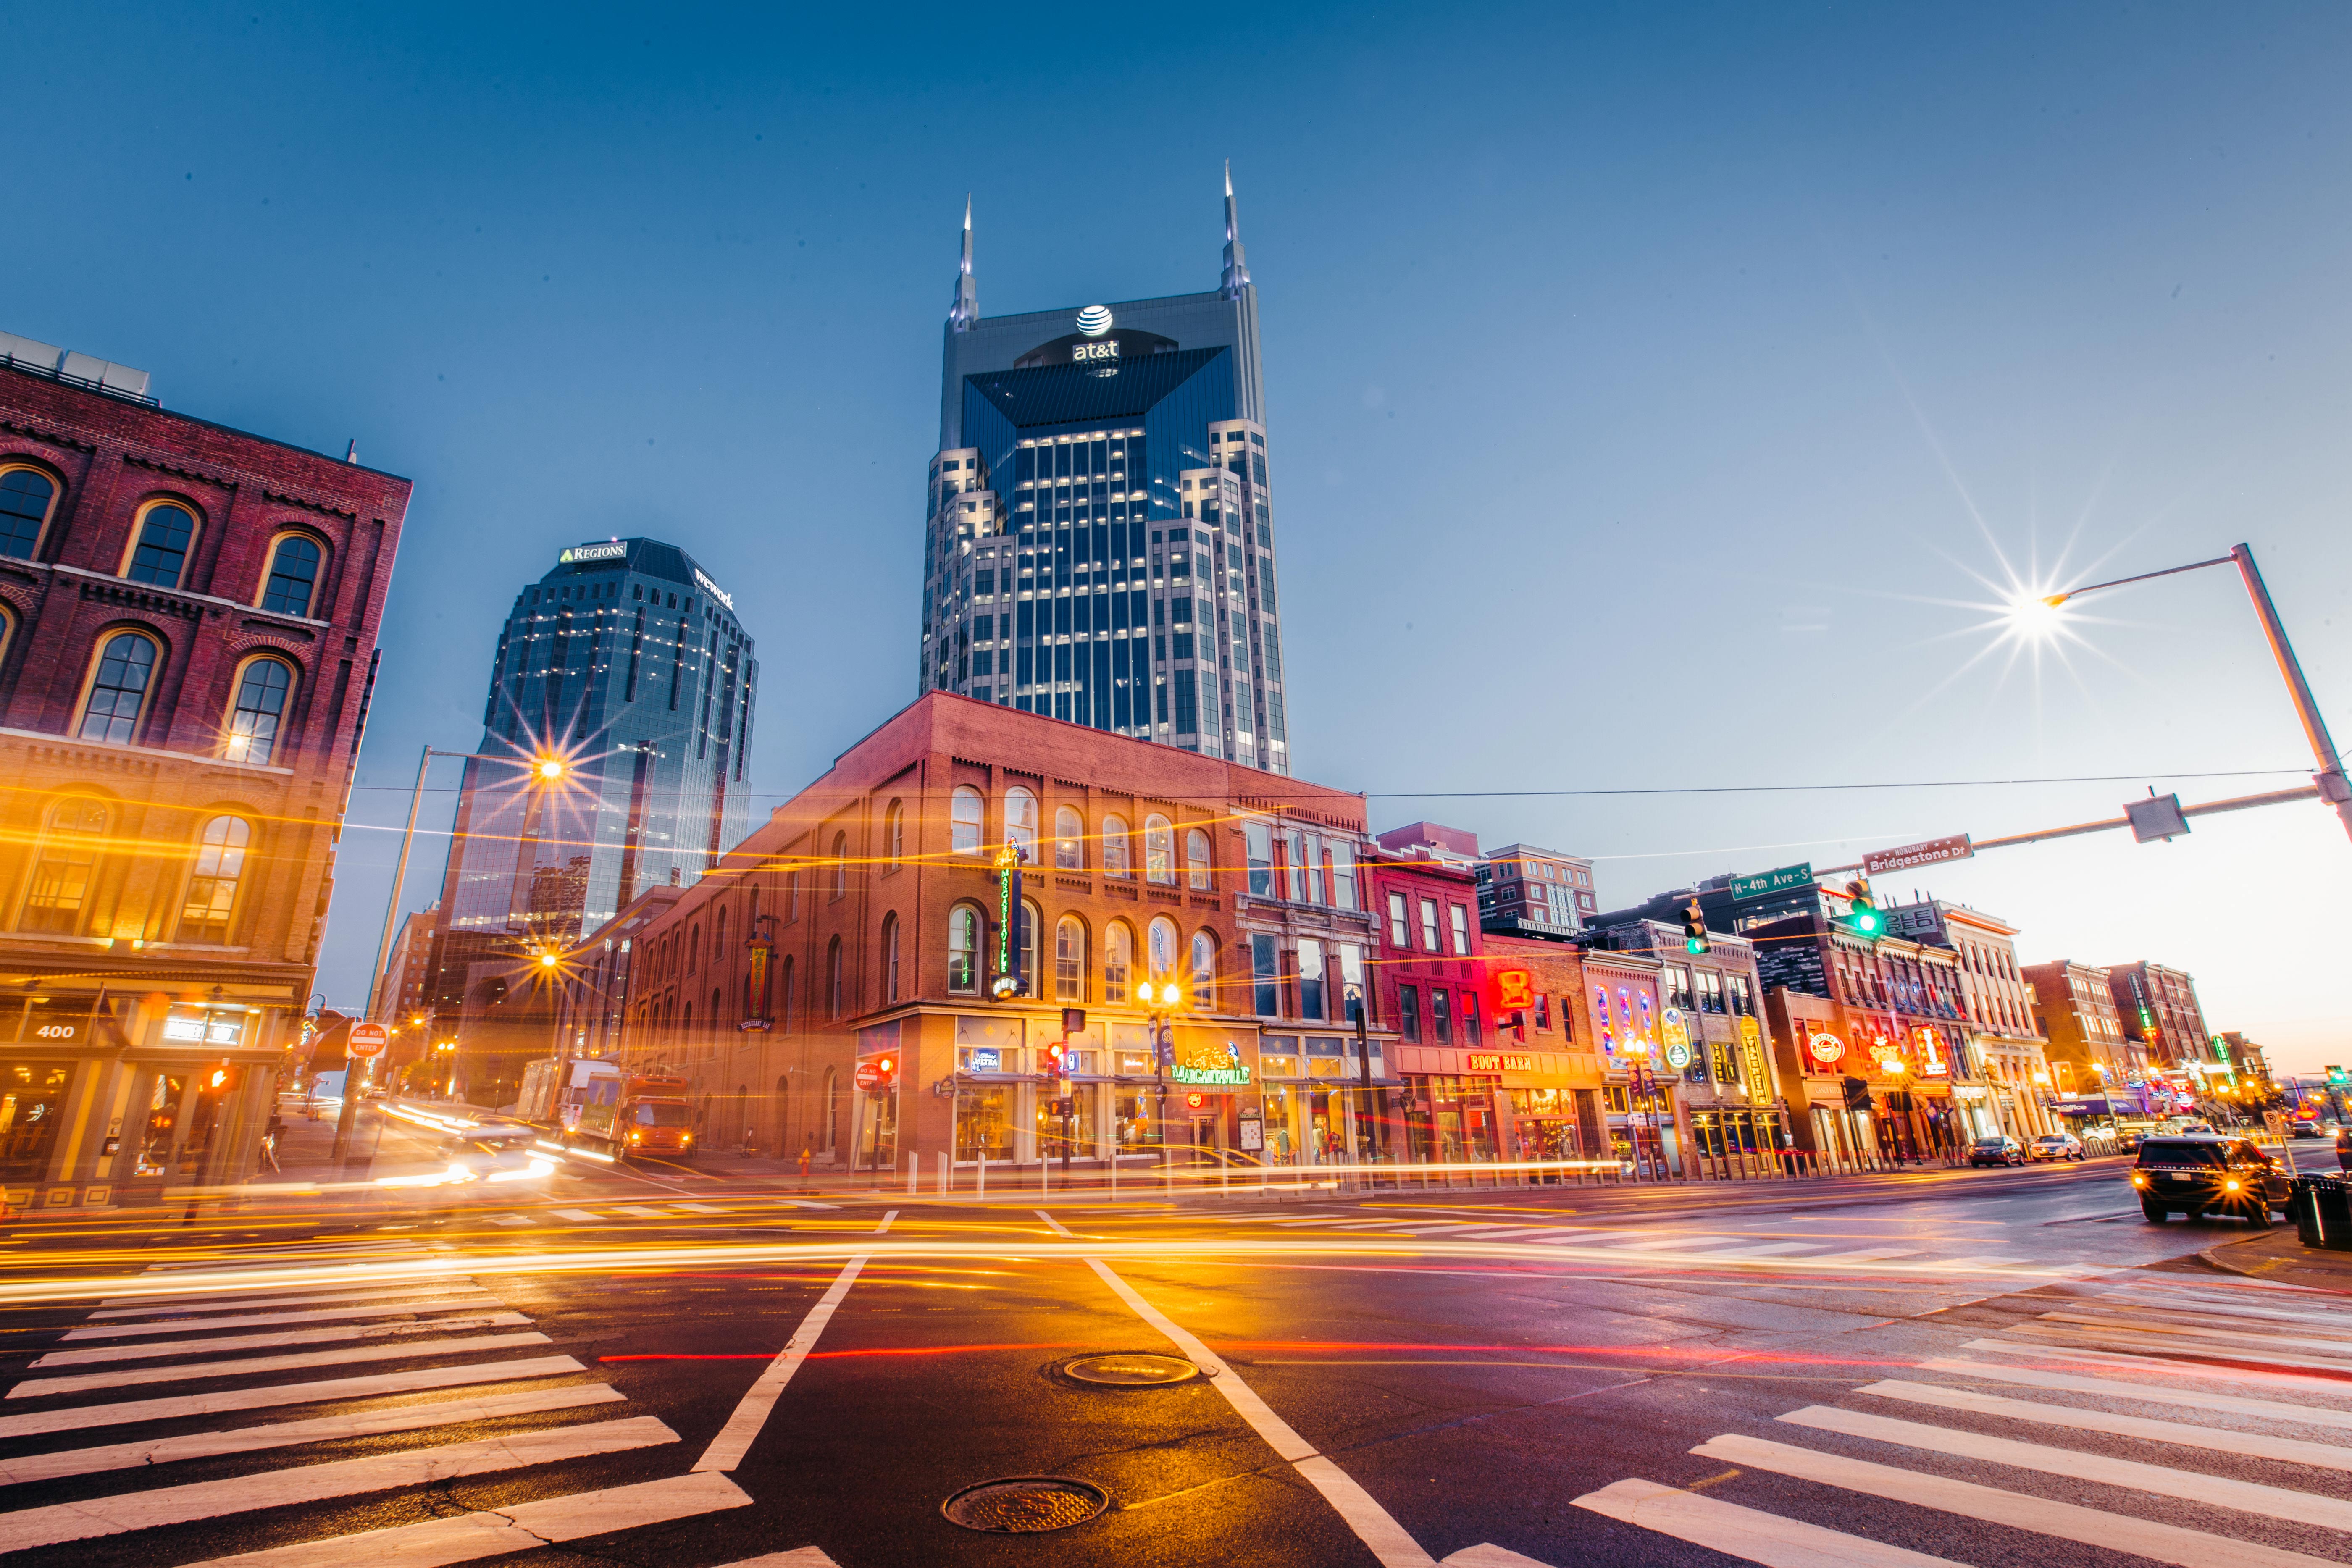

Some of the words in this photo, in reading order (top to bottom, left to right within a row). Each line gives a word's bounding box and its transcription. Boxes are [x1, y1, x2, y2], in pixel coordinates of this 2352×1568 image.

[1074, 341, 1117, 360] at&t
[574, 546, 624, 560] REGIONS
[695, 568, 733, 611] wework
[1895, 843, 1928, 856] HONORARY
[1870, 849, 1949, 871] Bridgestone
[1951, 846, 1965, 856] Dr
[1000, 868, 1010, 973] MARGARITAVILLE
[1884, 909, 1931, 924] OLE
[1886, 919, 1933, 932] RED
[36, 1025, 75, 1038] 400
[1470, 1055, 1499, 1070] BOOT
[1502, 1056, 1532, 1071] BARN
[1171, 1065, 1251, 1085] MARGARITAVILLE
